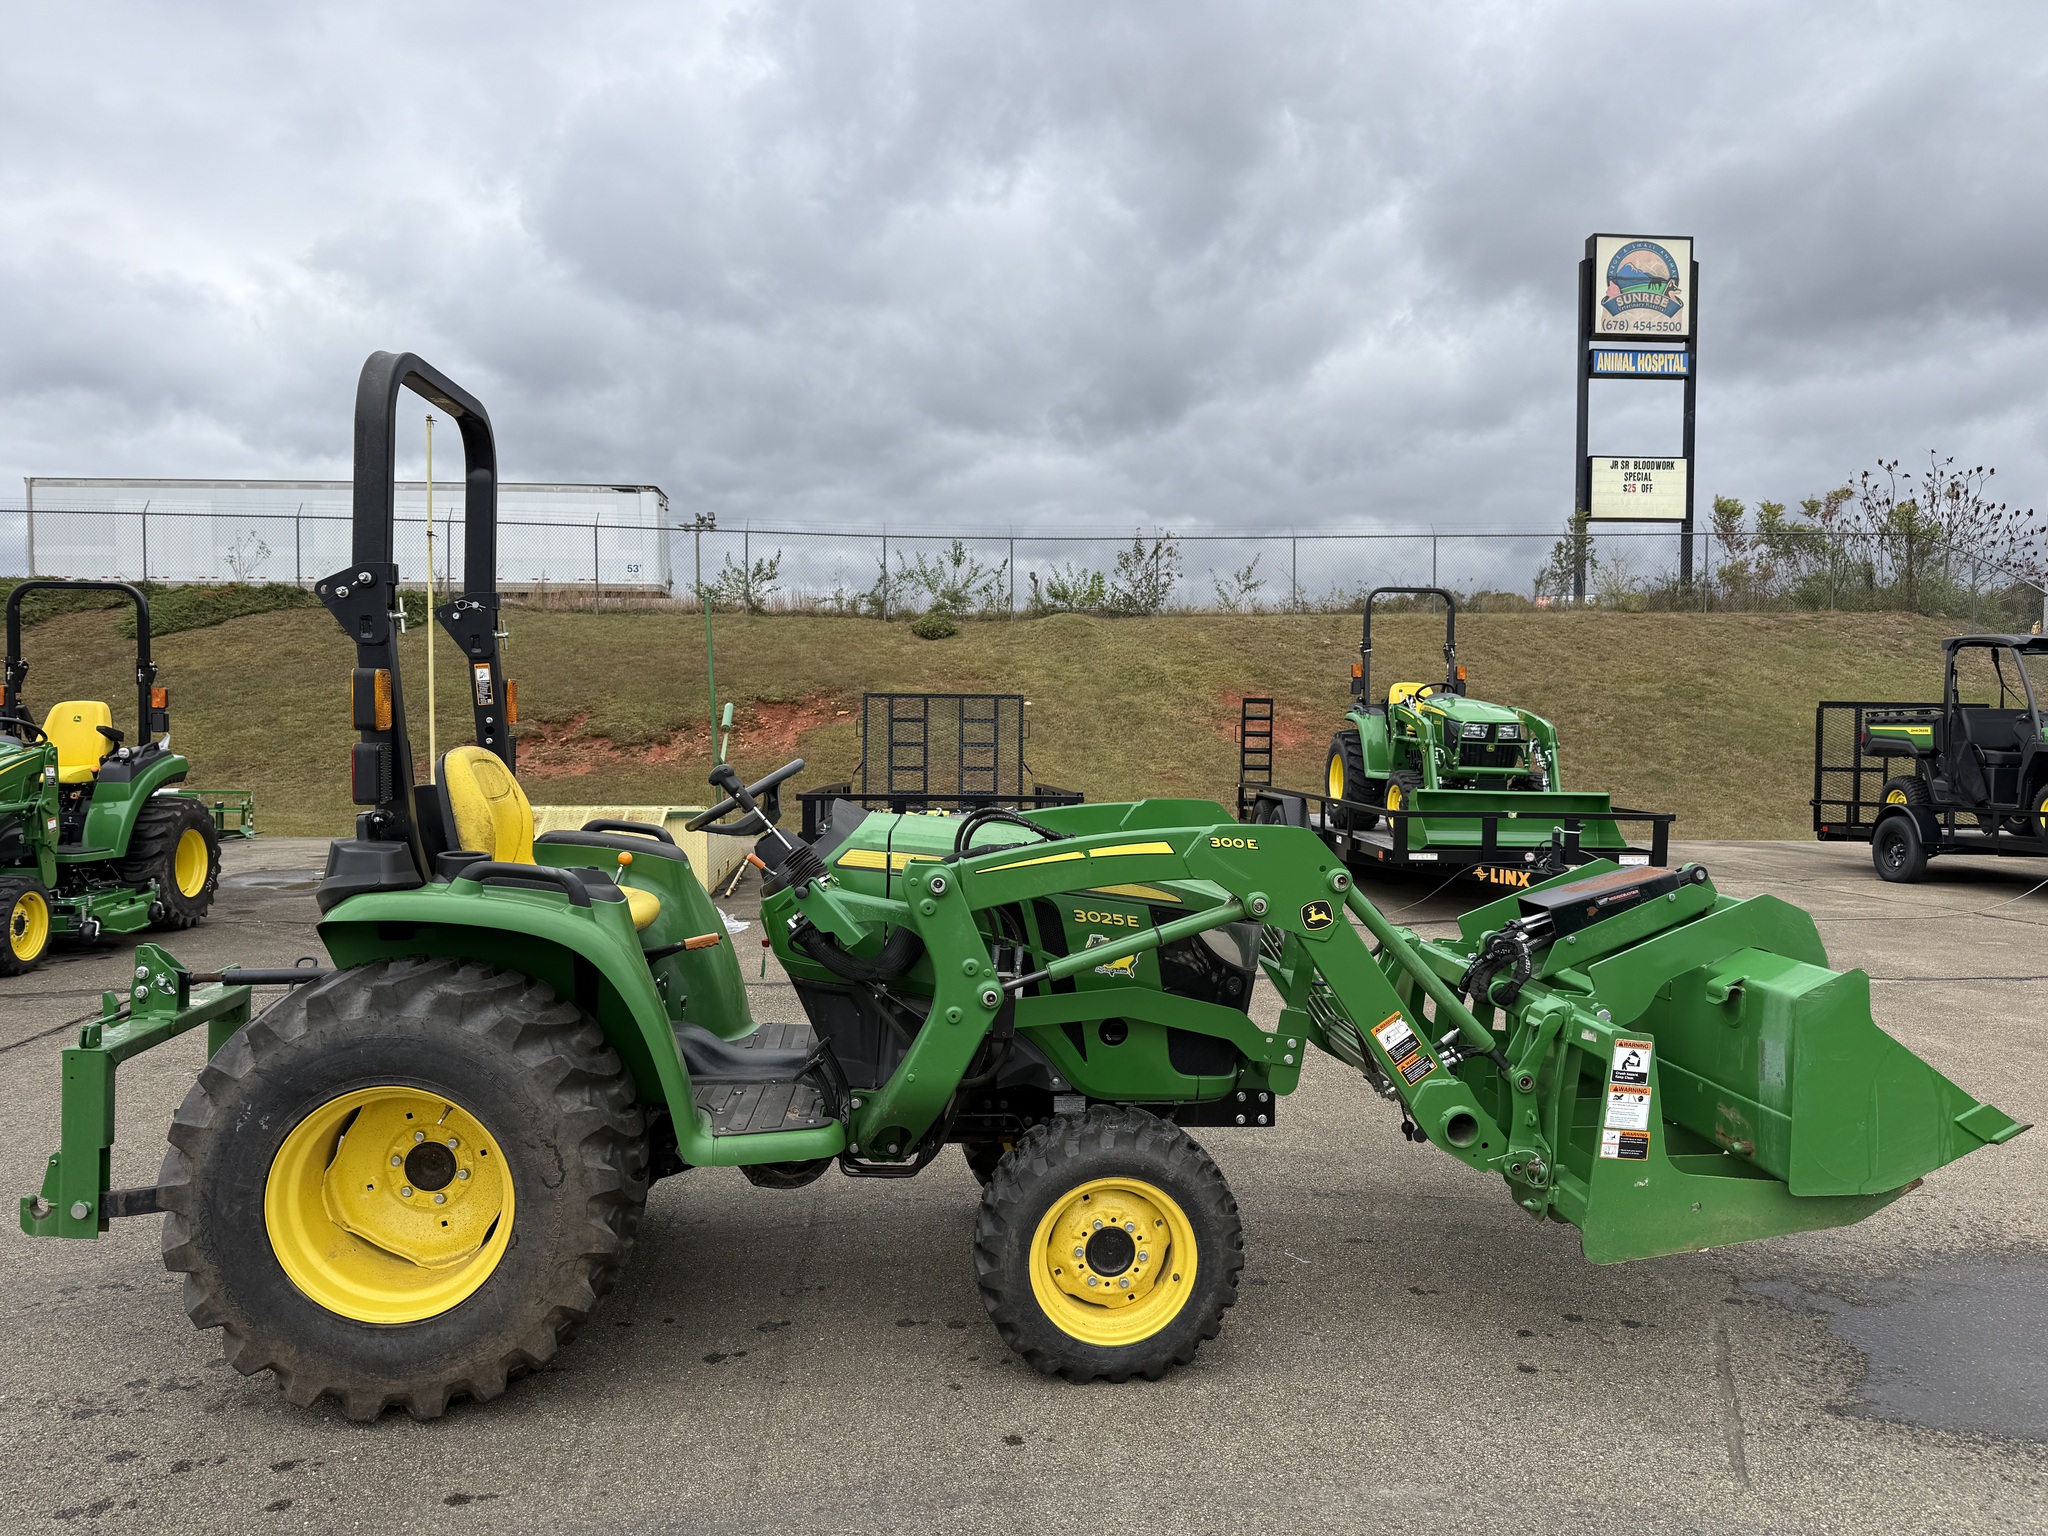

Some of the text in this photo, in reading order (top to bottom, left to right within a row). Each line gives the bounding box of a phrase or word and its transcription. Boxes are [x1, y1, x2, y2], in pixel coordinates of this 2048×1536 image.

[1660, 250, 1678, 278] ANIMAL
[1616, 292, 1670, 308] SUNRISE
[1618, 302, 1667, 313] Veterinary Hospital
[1602, 319, 1682, 332] (678) 454-5500
[1597, 352, 1687, 373] ANIMAL HOSPITAL
[1610, 460, 1675, 470] JR SR BLOODWORK
[1624, 472, 1652, 482] SPECIAL
[1622, 484, 1653, 493] $25 OFF
[1490, 867, 1531, 888] LINX
[1623, 1041, 1649, 1049] WARNING
[1618, 1086, 1648, 1094] WARNING
